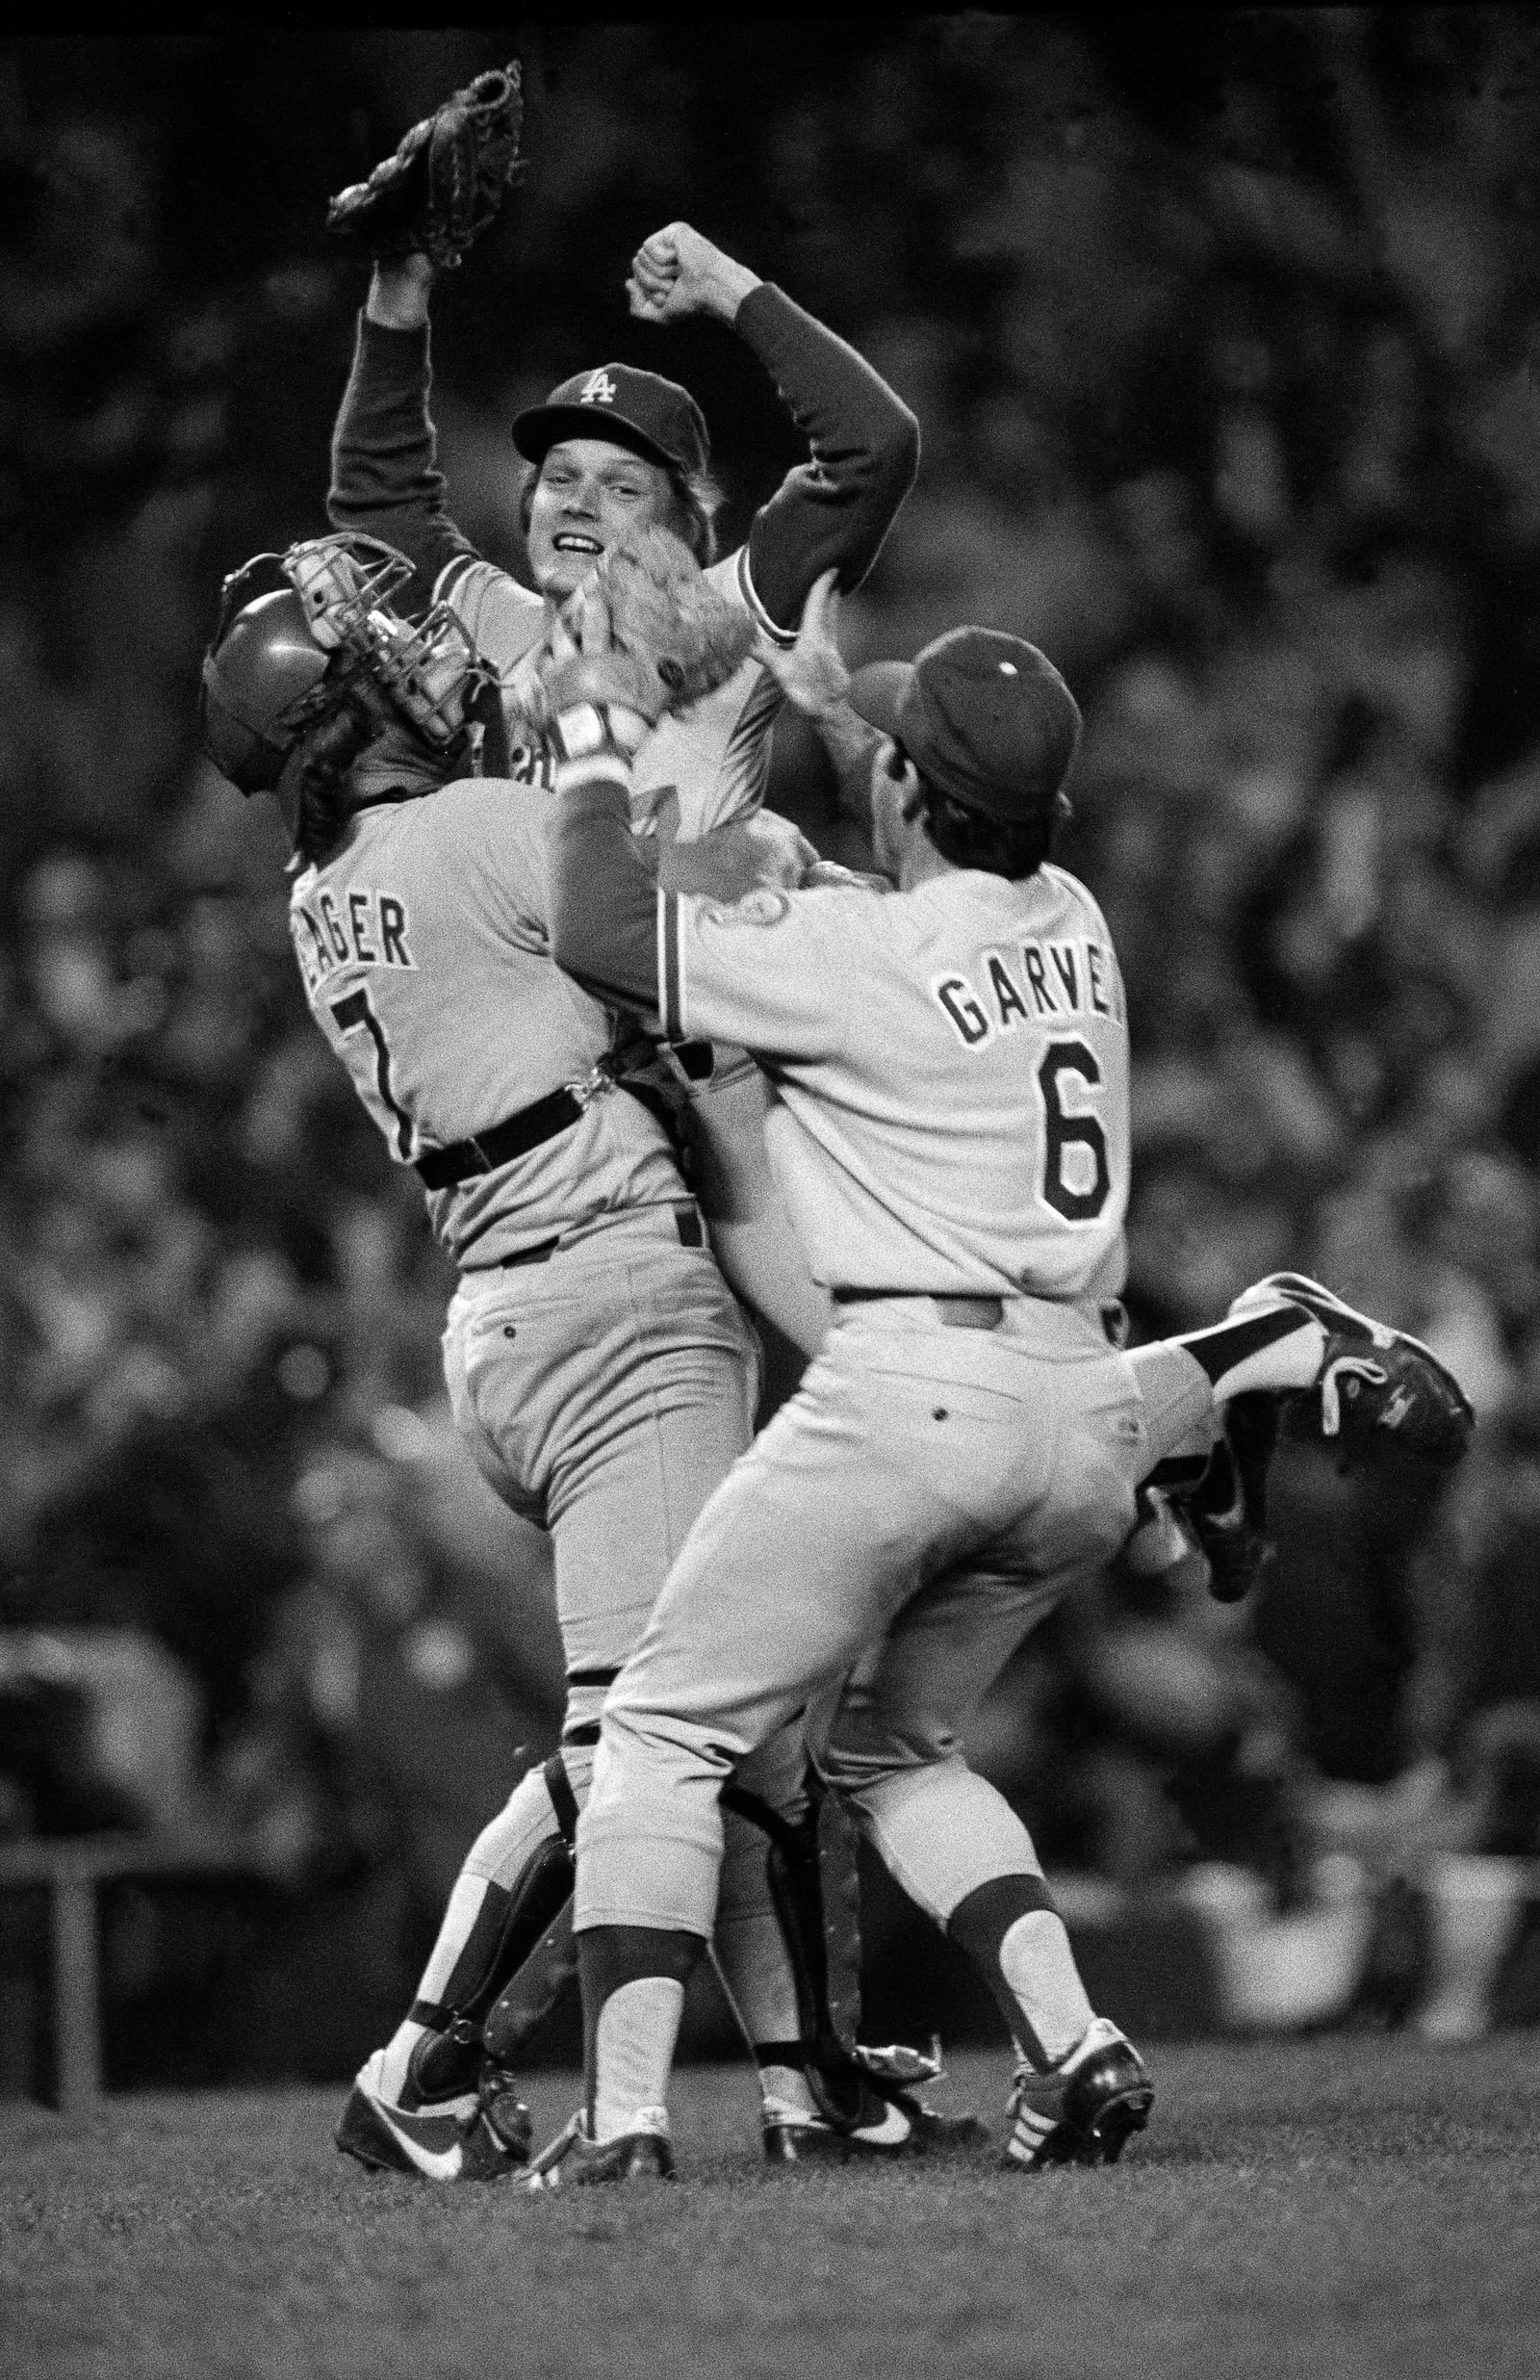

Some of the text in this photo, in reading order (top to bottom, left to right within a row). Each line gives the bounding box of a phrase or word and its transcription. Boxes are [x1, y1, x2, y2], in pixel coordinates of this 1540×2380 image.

[298, 892, 410, 986] AGER
[330, 988, 412, 1160] 7
[1038, 1041, 1110, 1221] 6
